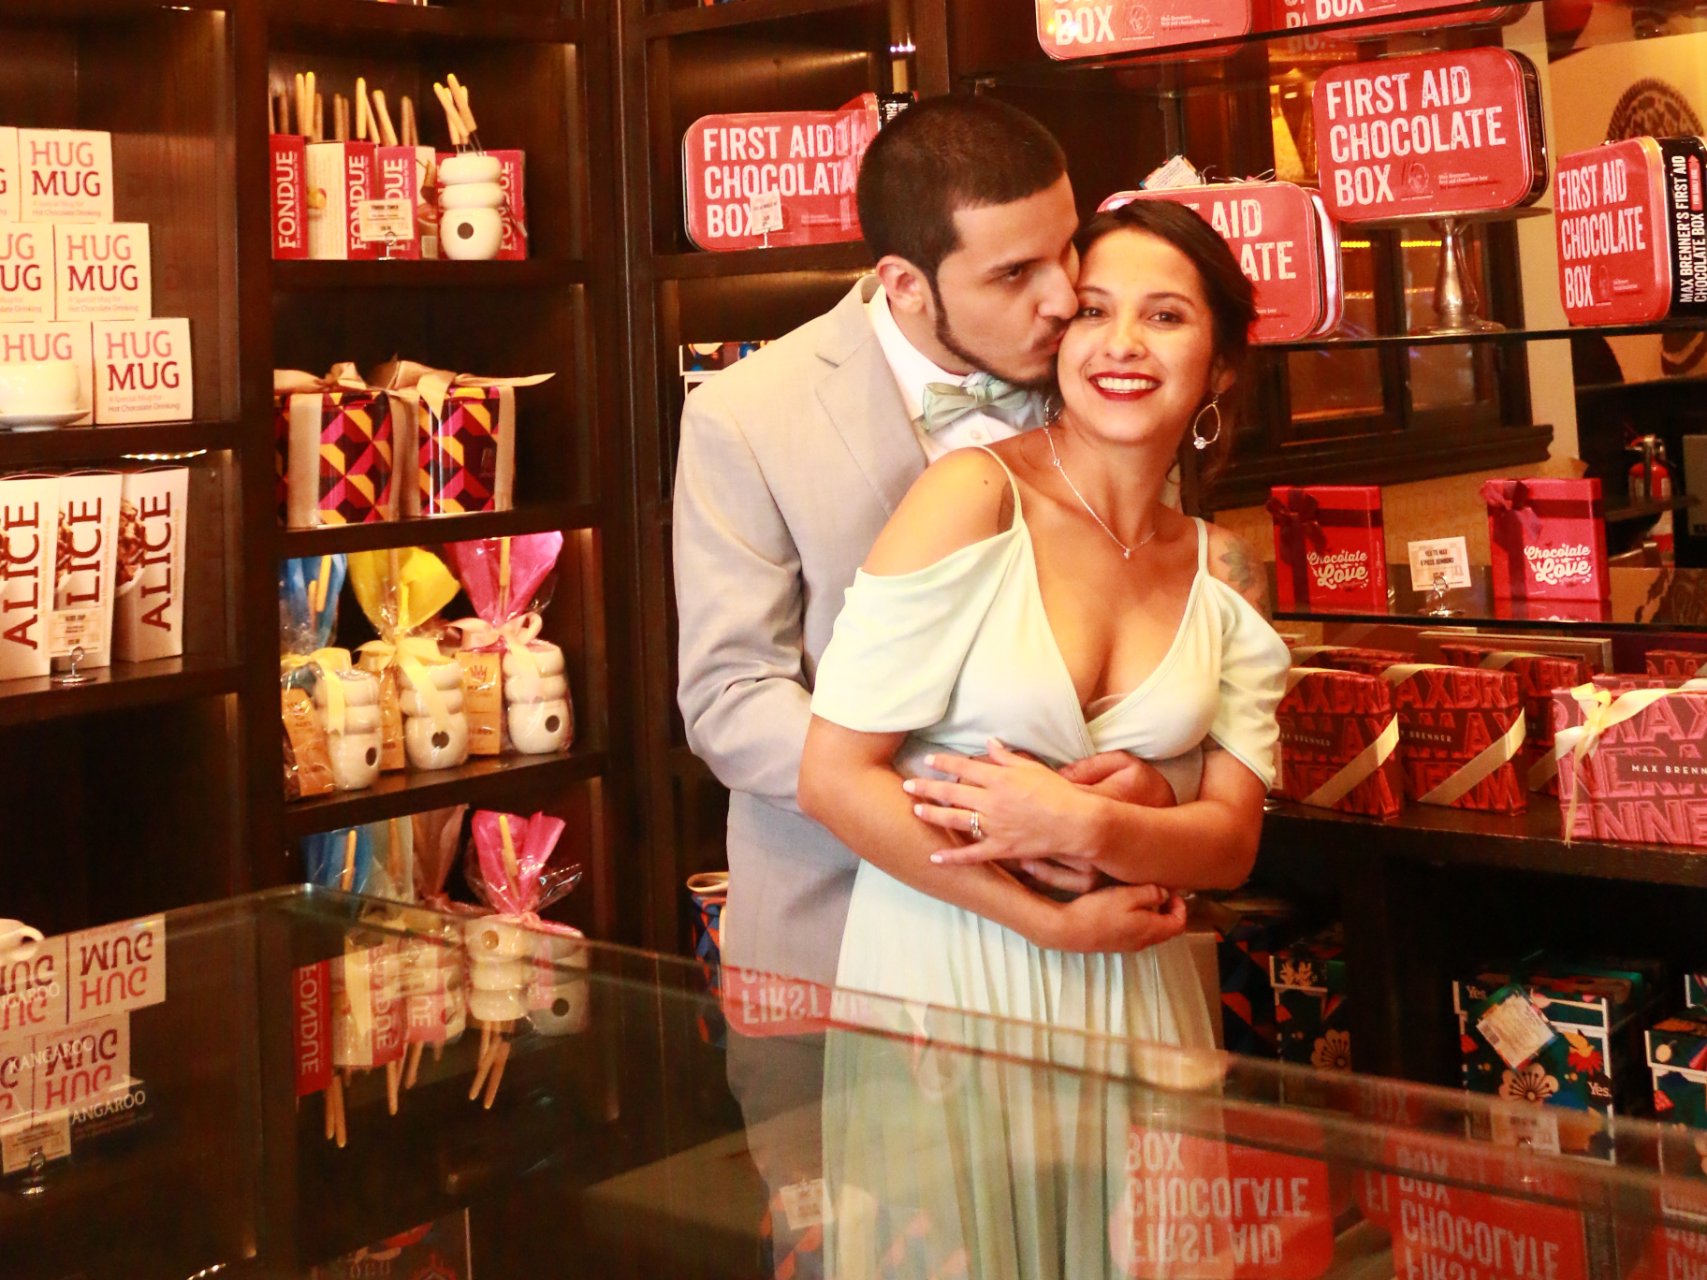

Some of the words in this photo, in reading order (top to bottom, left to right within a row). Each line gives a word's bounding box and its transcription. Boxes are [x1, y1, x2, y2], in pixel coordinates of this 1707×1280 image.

[1054, 5, 1115, 46] BOX
[1326, 73, 1410, 120] FIRST
[1422, 66, 1471, 108] AID
[703, 126, 781, 161] FIRST
[789, 124, 834, 159] AID
[1330, 106, 1506, 163] CHOCOLATE
[30, 140, 94, 168] HUG
[1672, 155, 1686, 174] AID
[31, 170, 101, 198] MUG
[704, 161, 842, 200] CHOCOLAT
[1334, 164, 1394, 207] BOX
[1558, 164, 1597, 212] FIRST
[1603, 158, 1627, 205] AID
[1674, 177, 1689, 209] FIRST
[276, 150, 296, 249] FONDUE
[1211, 199, 1263, 239] AID
[1561, 206, 1646, 260] CHOCOLATE
[1691, 213, 1705, 235] BOX
[0, 233, 35, 261] UG
[66, 234, 132, 261] HUG
[1677, 212, 1692, 276] BRENNER'S
[0, 265, 41, 292] UG
[68, 265, 139, 292] MUG
[1564, 265, 1593, 308] BOX
[1693, 239, 1707, 302] CHOCOLATE
[1680, 279, 1693, 303] MAX
[2, 333, 72, 362] HUG
[106, 330, 172, 359] HUG
[107, 361, 180, 391] MUG
[66, 497, 101, 606] LICE
[141, 491, 171, 632] ALICE
[1307, 550, 1368, 566] Chocolate
[1524, 543, 1591, 560] Chocolate
[3, 502, 39, 650] ALICE
[1317, 563, 1369, 590] Love
[1535, 558, 1592, 585] Love
[1409, 729, 1453, 743] BRENNER
[1631, 764, 1658, 773] MAX
[9, 1039, 94, 1073] KANGAROO
[72, 1089, 146, 1125] ANGAROO
